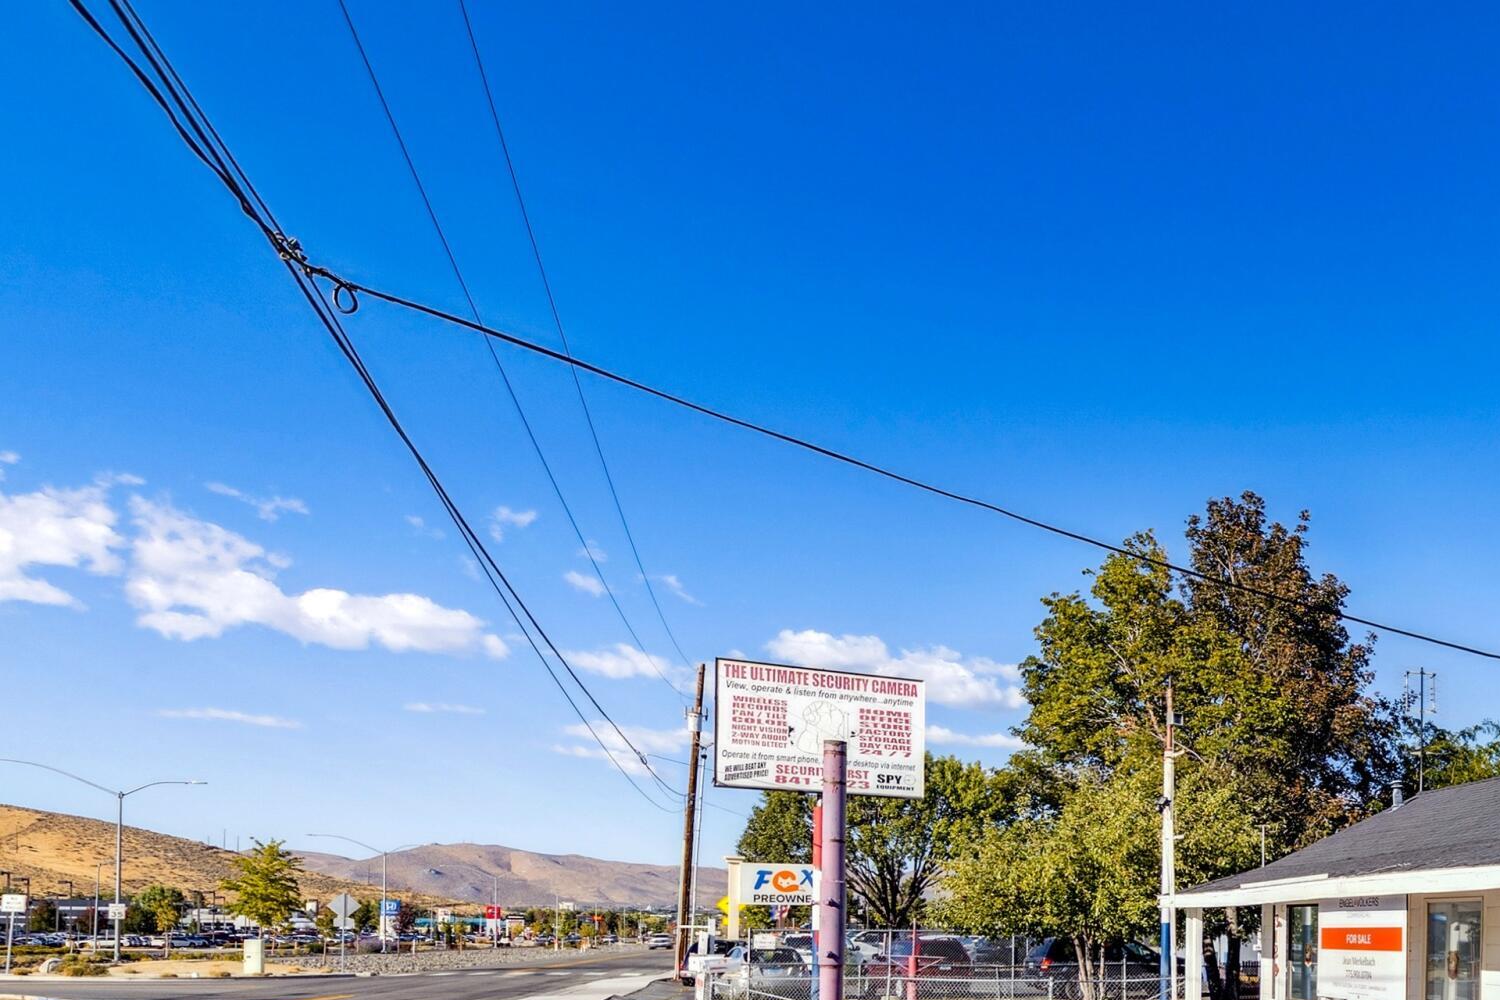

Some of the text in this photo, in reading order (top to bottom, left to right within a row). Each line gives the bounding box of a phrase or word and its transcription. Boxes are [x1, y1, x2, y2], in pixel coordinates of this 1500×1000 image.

[724, 663, 918, 698] THE ULTIMATE SECURITY CAMERA
[726, 680, 748, 691] View,
[751, 684, 783, 694] operate
[786, 686, 791, 694] &
[794, 688, 816, 697] listen
[818, 690, 836, 700] from
[733, 695, 788, 706] WIRELESS
[732, 702, 788, 713] RECORDS
[766, 712, 786, 720] TILT
[860, 708, 912, 718] HOME
[732, 716, 787, 726] COLOR
[860, 715, 912, 724] OFFICE
[732, 724, 788, 734] NIGHT VISION
[860, 722, 912, 731] STORE
[732, 731, 760, 739] 2-WAY
[860, 728, 912, 738] FACTORY
[732, 738, 788, 748] MOTION DETECT
[860, 735, 912, 744] STORAGE
[884, 744, 912, 752] CARE
[722, 750, 750, 760] Operate
[758, 752, 774, 760] from
[853, 760, 879, 768] desktop
[891, 763, 916, 771] internet
[745, 762, 756, 770] BEAT
[877, 774, 902, 784] SPY
[754, 869, 813, 892] FOX
[753, 894, 812, 903] PREOWNE
[1346, 934, 1372, 944] FOR SALE
